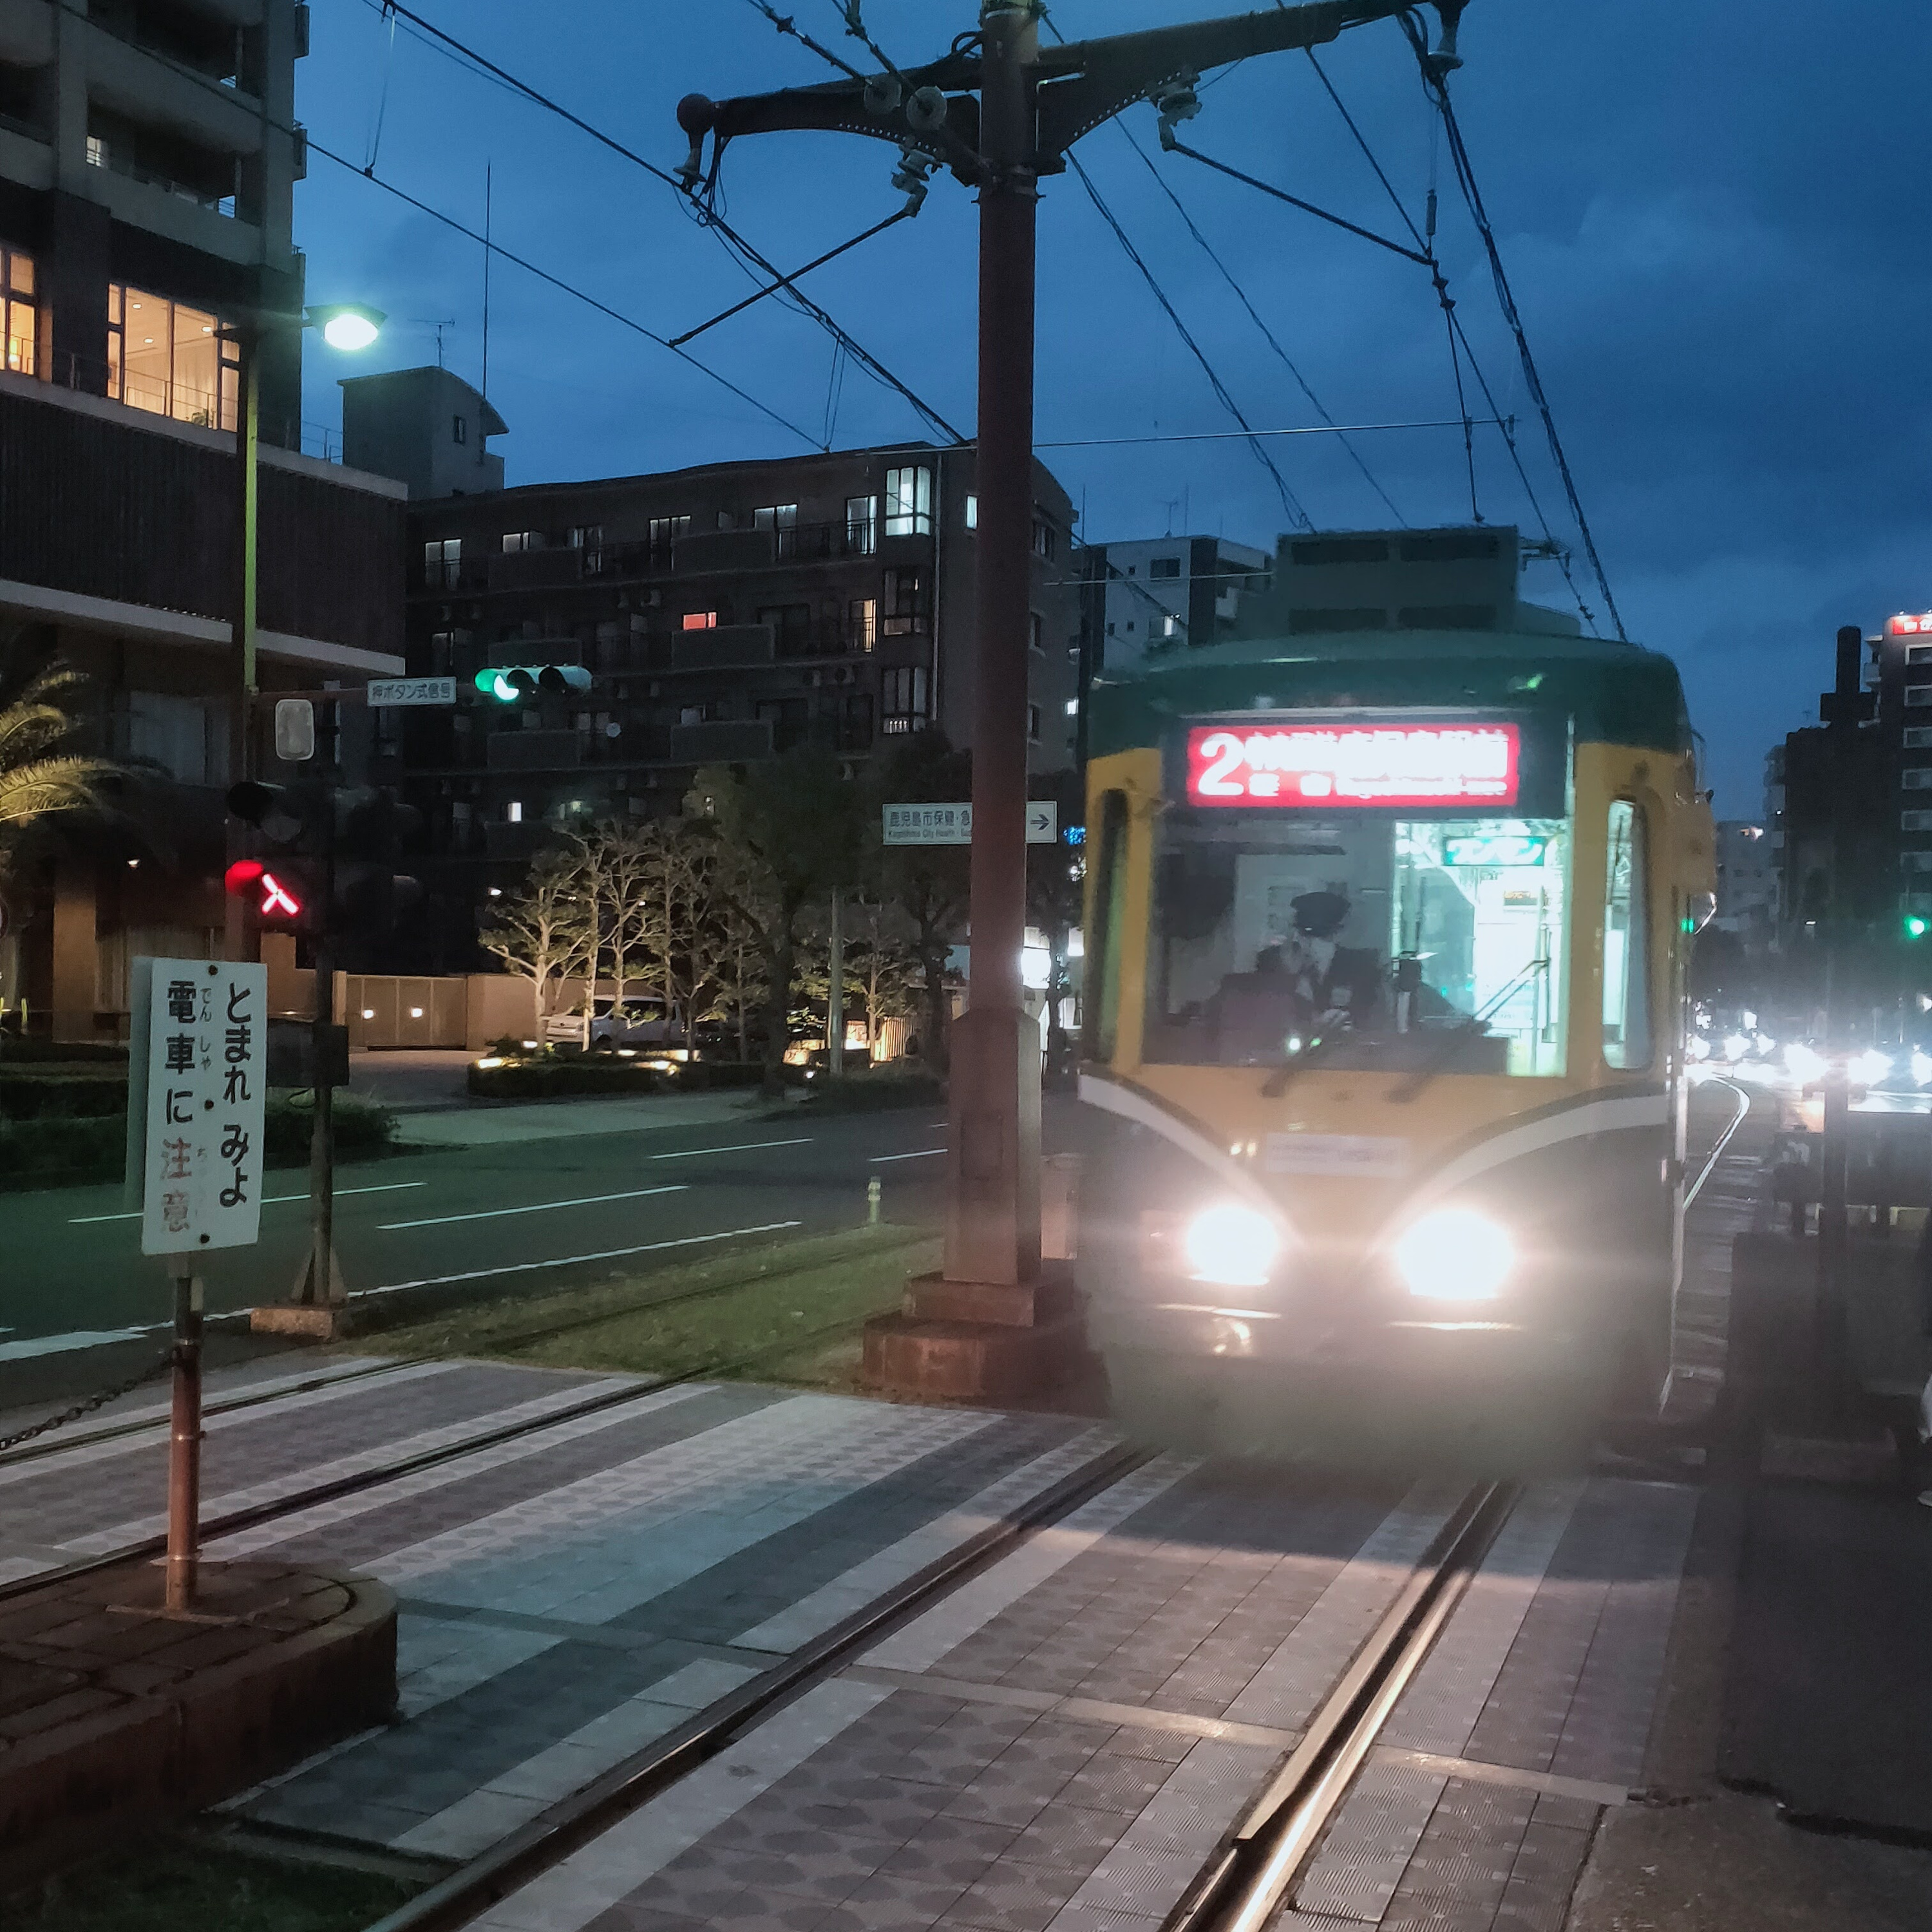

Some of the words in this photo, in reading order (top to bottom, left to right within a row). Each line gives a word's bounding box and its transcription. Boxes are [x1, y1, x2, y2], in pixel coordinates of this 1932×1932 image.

[372, 682, 450, 699] 押ボタン式信号
[1198, 732, 1244, 797] 2
[223, 981, 251, 1105] とまれ
[219, 1123, 249, 1209] みよ
